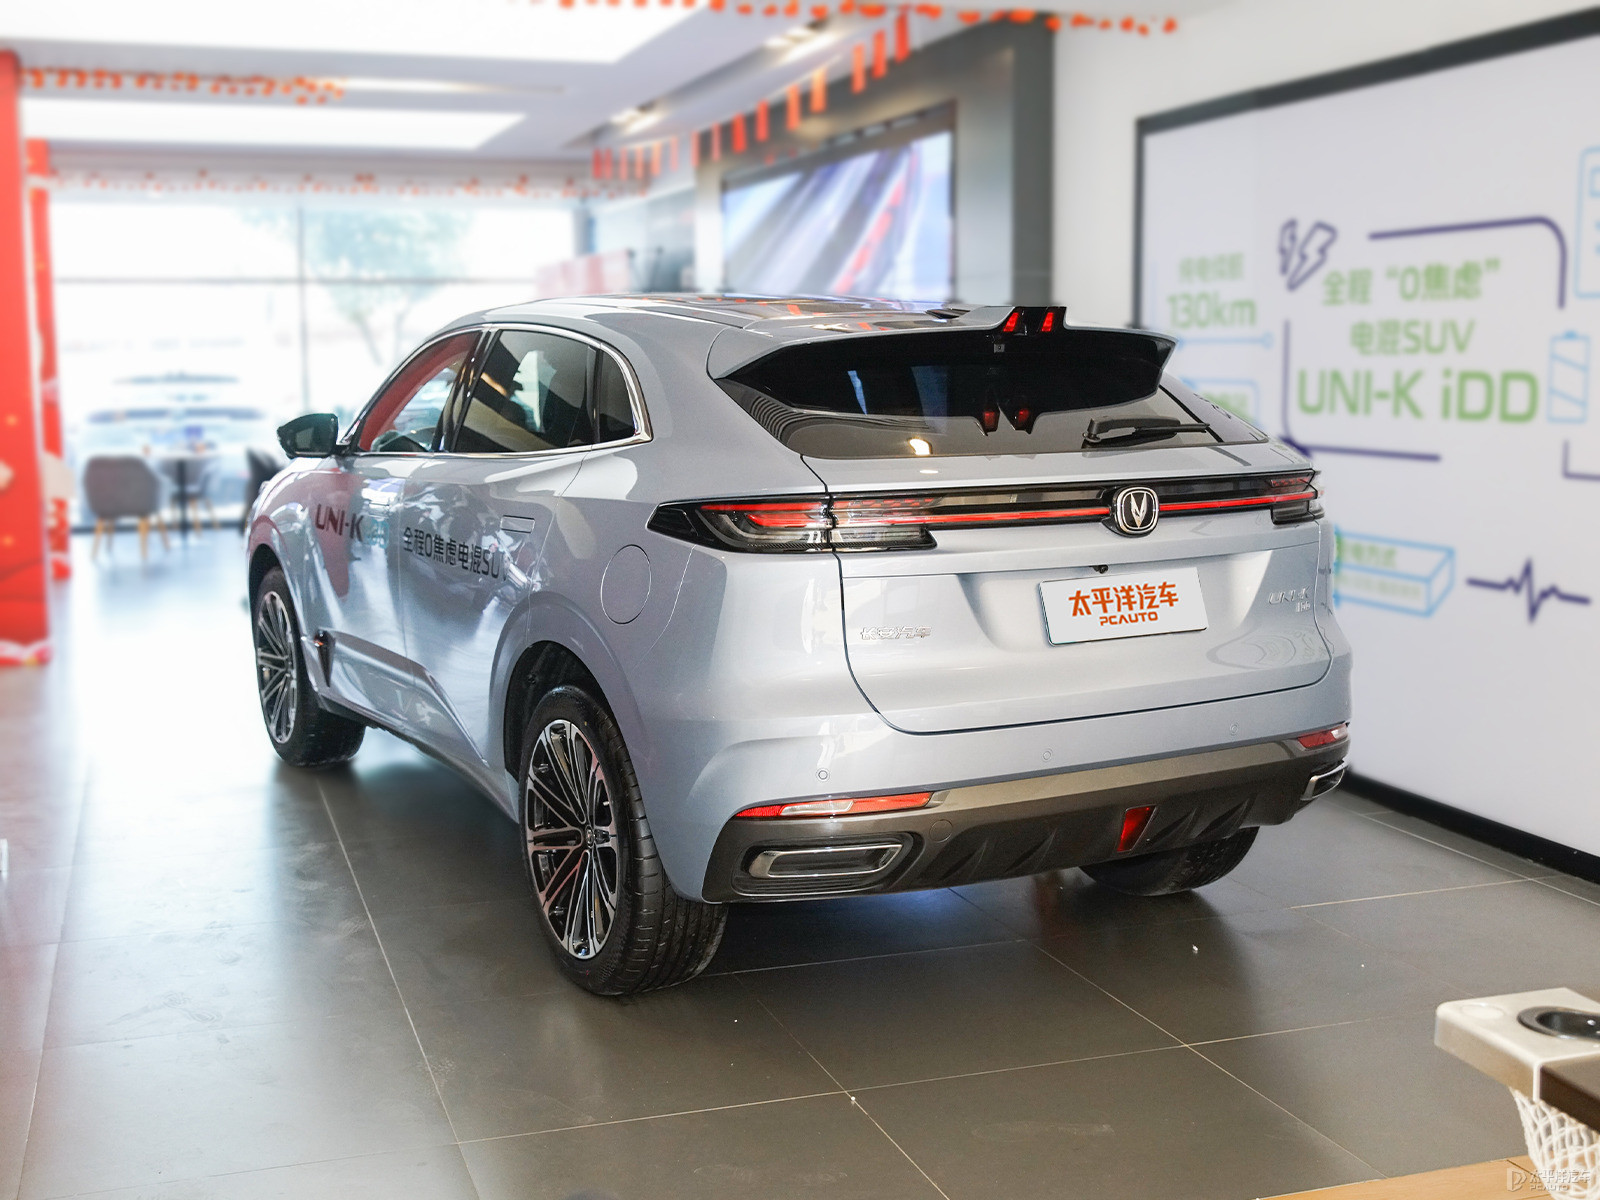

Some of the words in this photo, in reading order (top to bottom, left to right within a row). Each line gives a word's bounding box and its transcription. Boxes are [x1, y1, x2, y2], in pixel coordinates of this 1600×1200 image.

[1167, 292, 1257, 328] 130km
[1299, 368, 1424, 420] UNI-K
[1440, 367, 1540, 424] iDD
[315, 503, 364, 543] UNI-K
[1068, 581, 1179, 617] 太平洋汽车
[1099, 611, 1159, 627] PCAUTO
